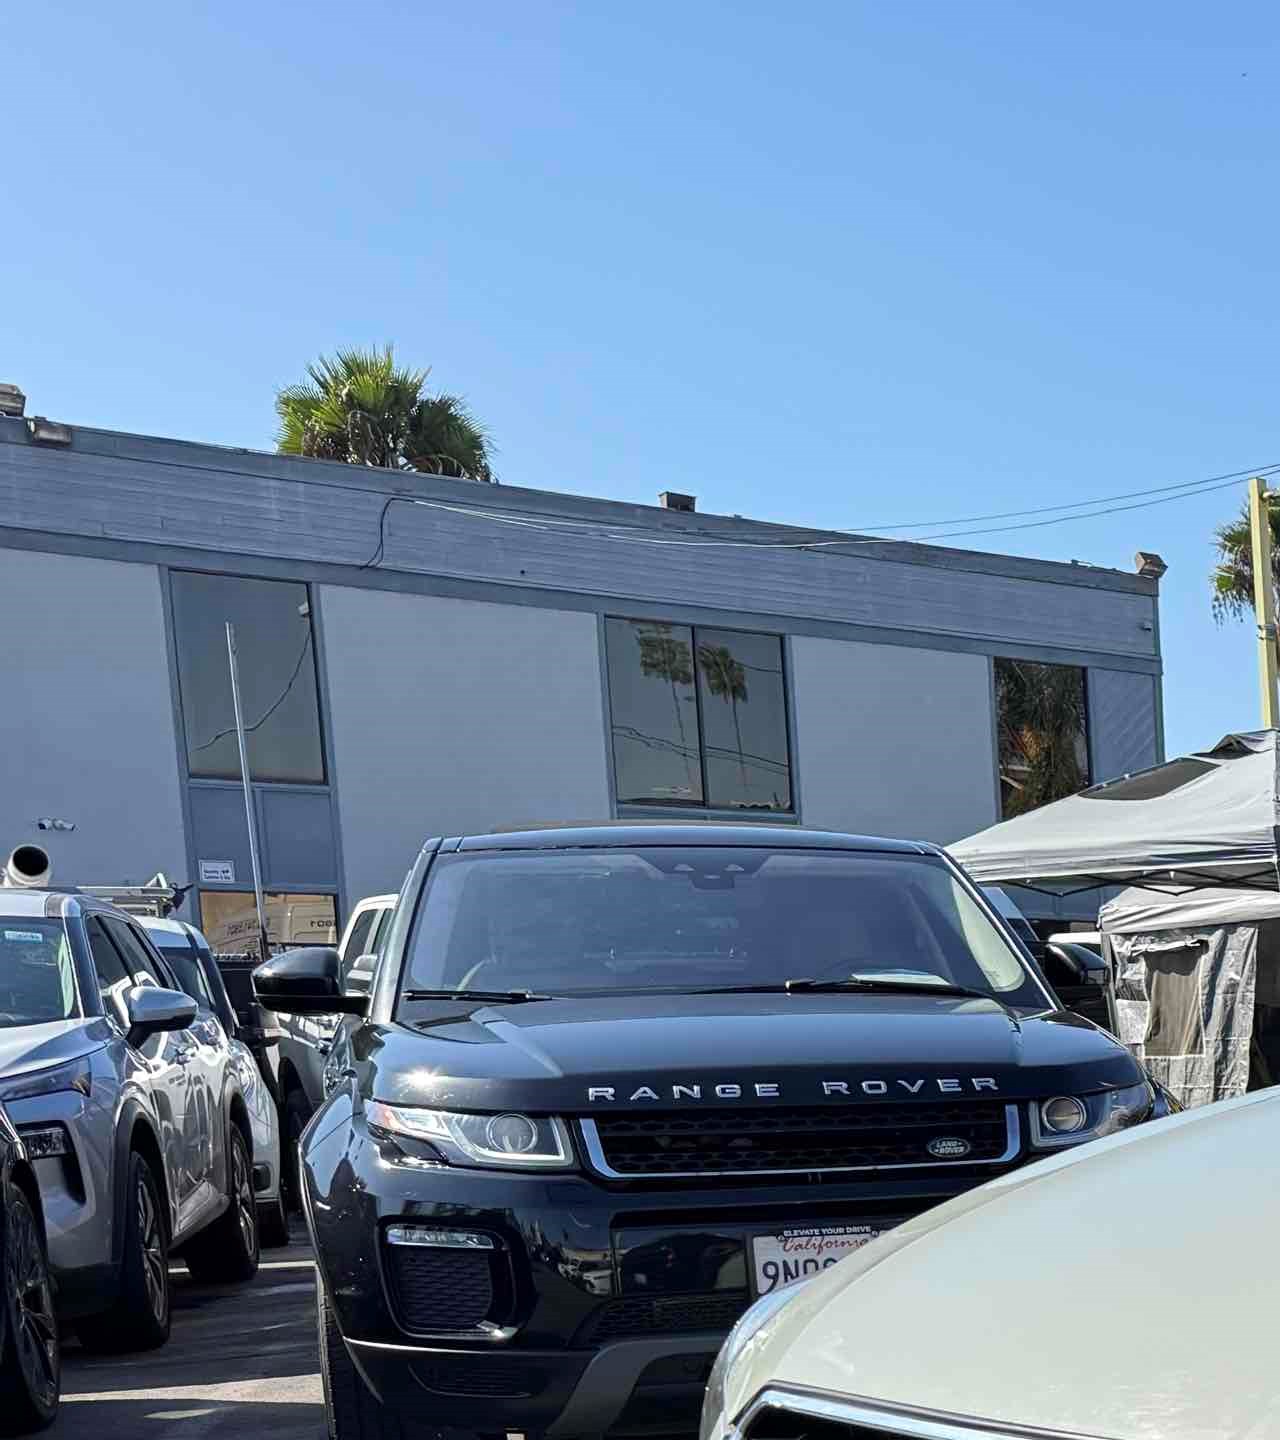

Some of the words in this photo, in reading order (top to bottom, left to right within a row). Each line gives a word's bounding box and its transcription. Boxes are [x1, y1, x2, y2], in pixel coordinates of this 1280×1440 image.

[588, 1083, 780, 1101] RANGE
[822, 1077, 999, 1096] ROVER
[783, 1229, 820, 1237] ELEVATE
[822, 1227, 845, 1235] YOUR
